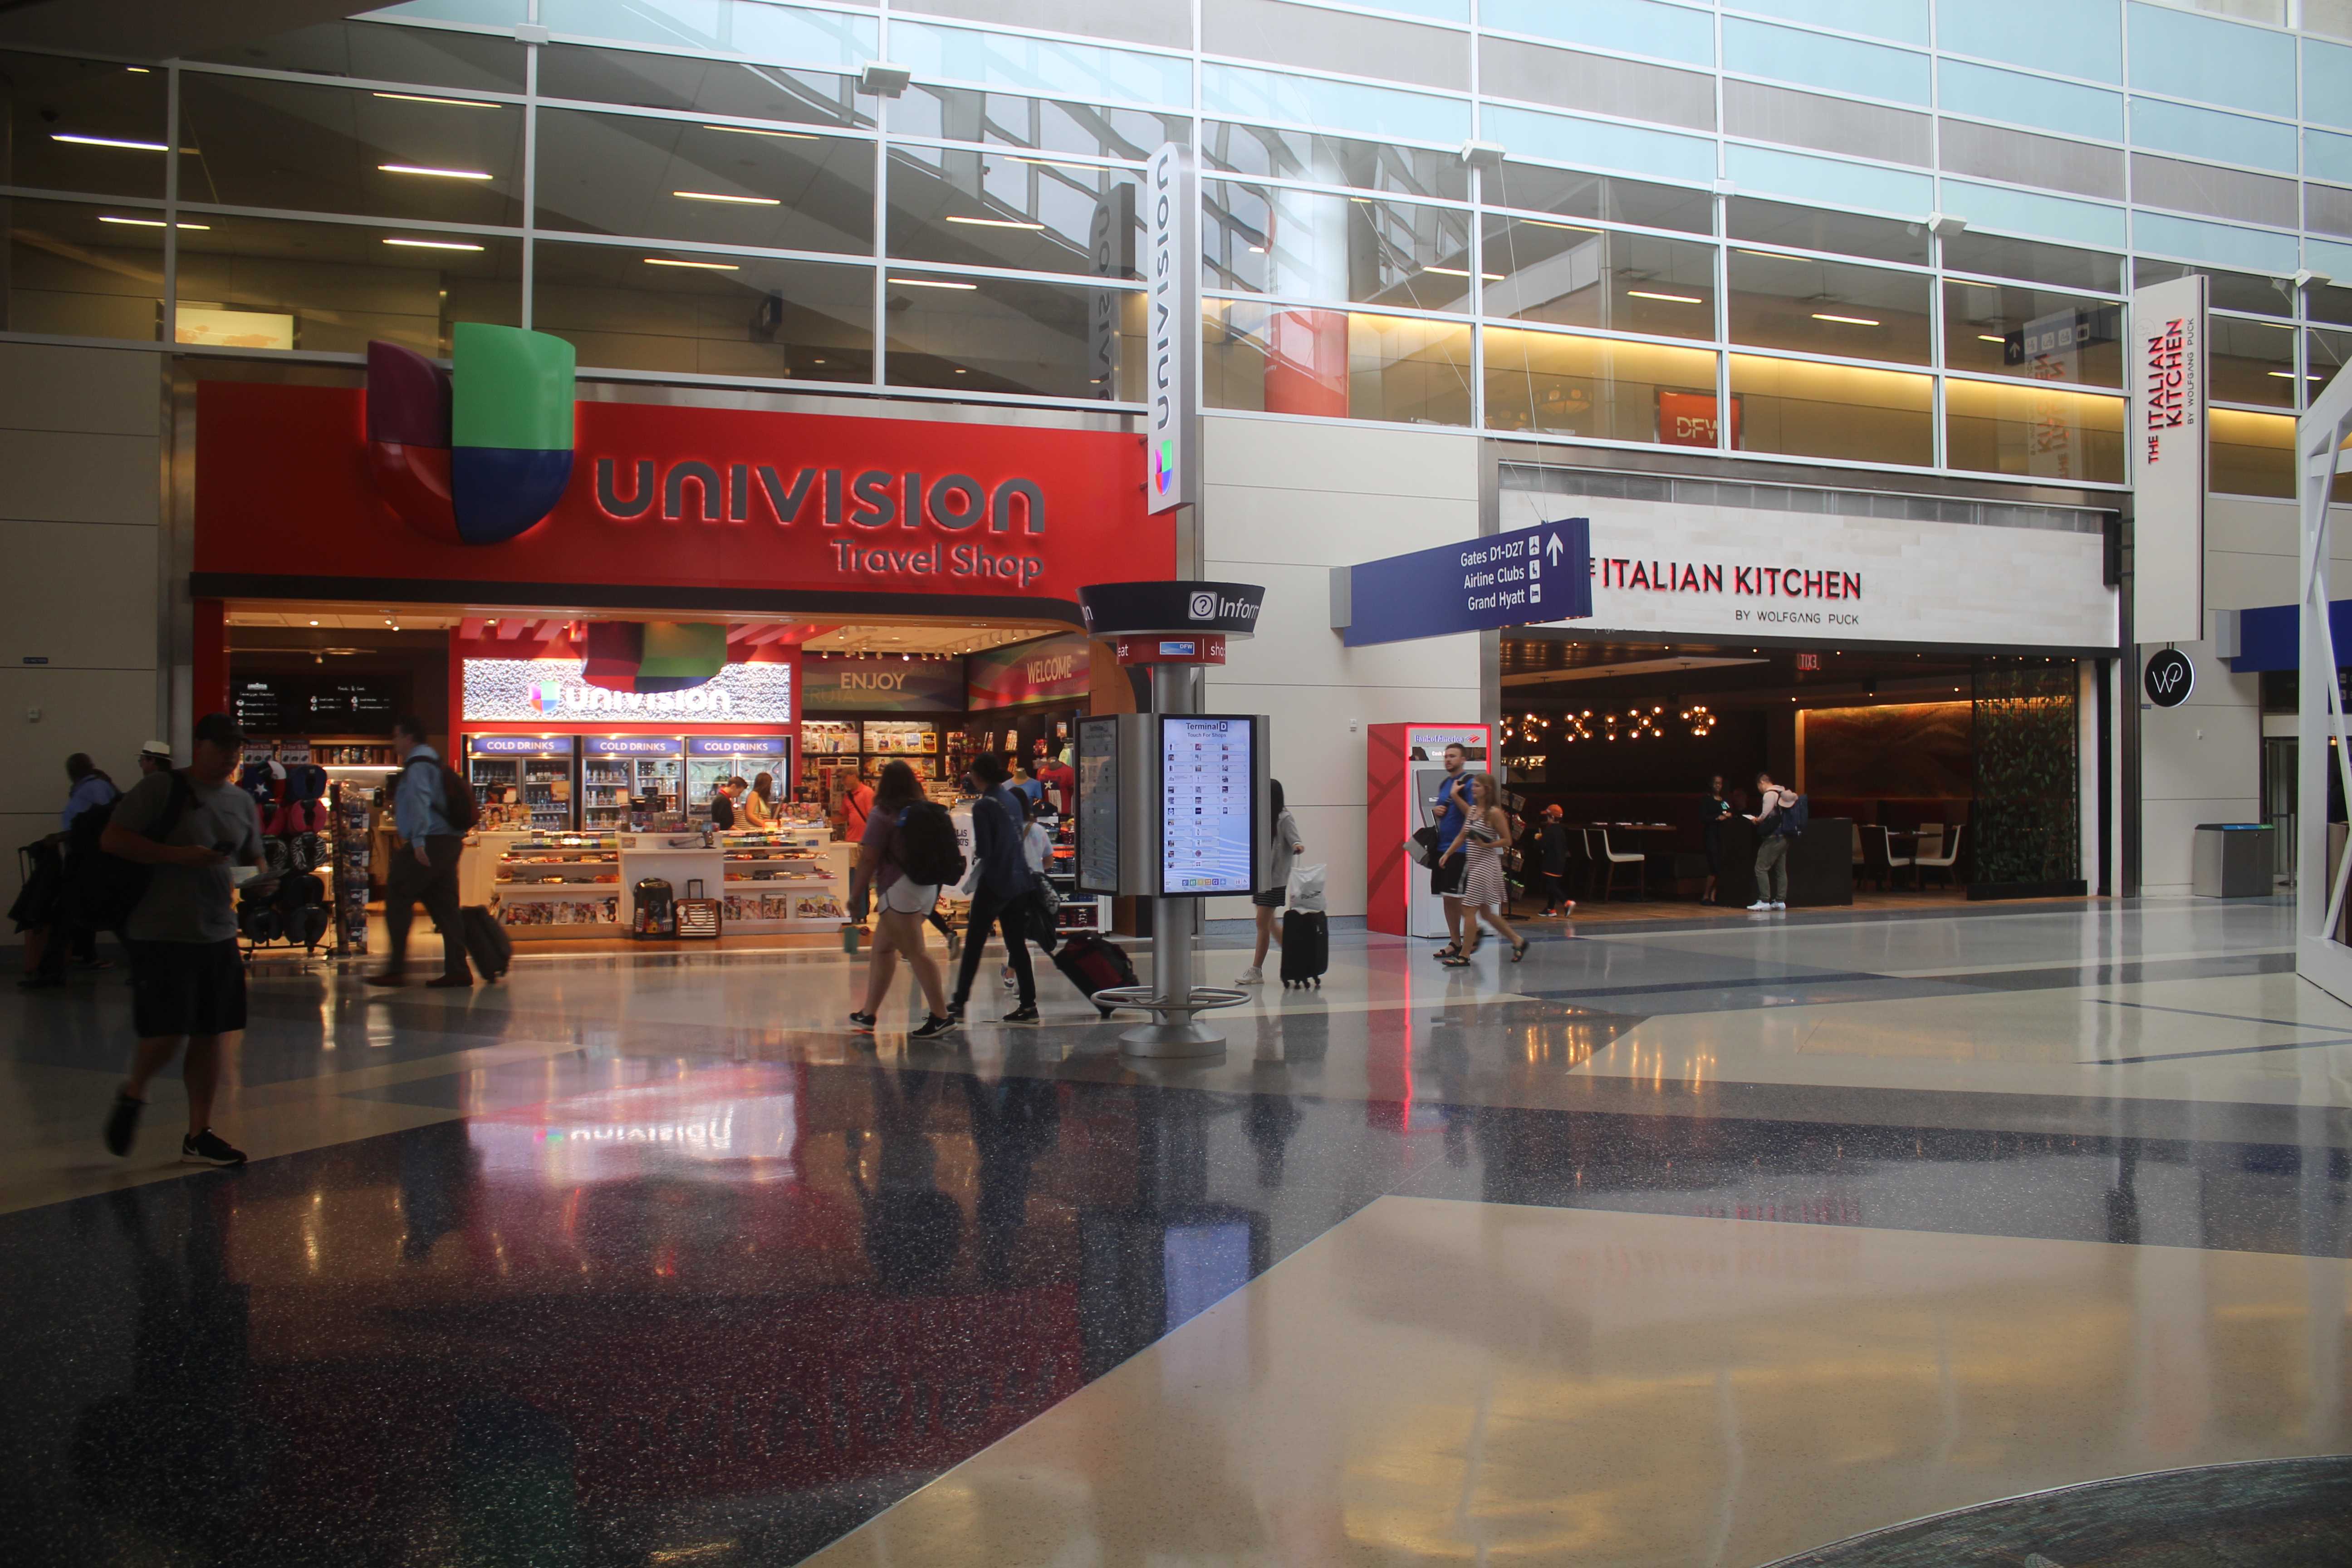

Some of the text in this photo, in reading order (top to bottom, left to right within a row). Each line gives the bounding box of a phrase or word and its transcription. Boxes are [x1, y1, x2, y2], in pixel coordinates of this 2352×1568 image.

[2148, 336, 2165, 431] ITALIAN
[2166, 318, 2185, 428] KITCHEN
[2187, 412, 2195, 425] BY
[2148, 435, 2159, 465] THE
[832, 539, 1044, 587] Travel Shop
[1460, 540, 1524, 567] Gates D1-D27
[1464, 562, 1525, 589] Airline Clubs
[1602, 558, 1723, 593] ITALIAN
[1734, 565, 1861, 599] KITCHEN
[1468, 589, 1525, 611] Grand Hyatt
[1735, 610, 1859, 625] BY WOLFGANG PUCK
[840, 672, 906, 690] ENJOY
[1027, 655, 1072, 684] WELCOME
[1186, 722, 1218, 730] Terminal
[487, 741, 554, 751] COLD DRINKS
[600, 742, 666, 752] COLD DRINKS
[704, 742, 768, 752] COLD DRINKS
